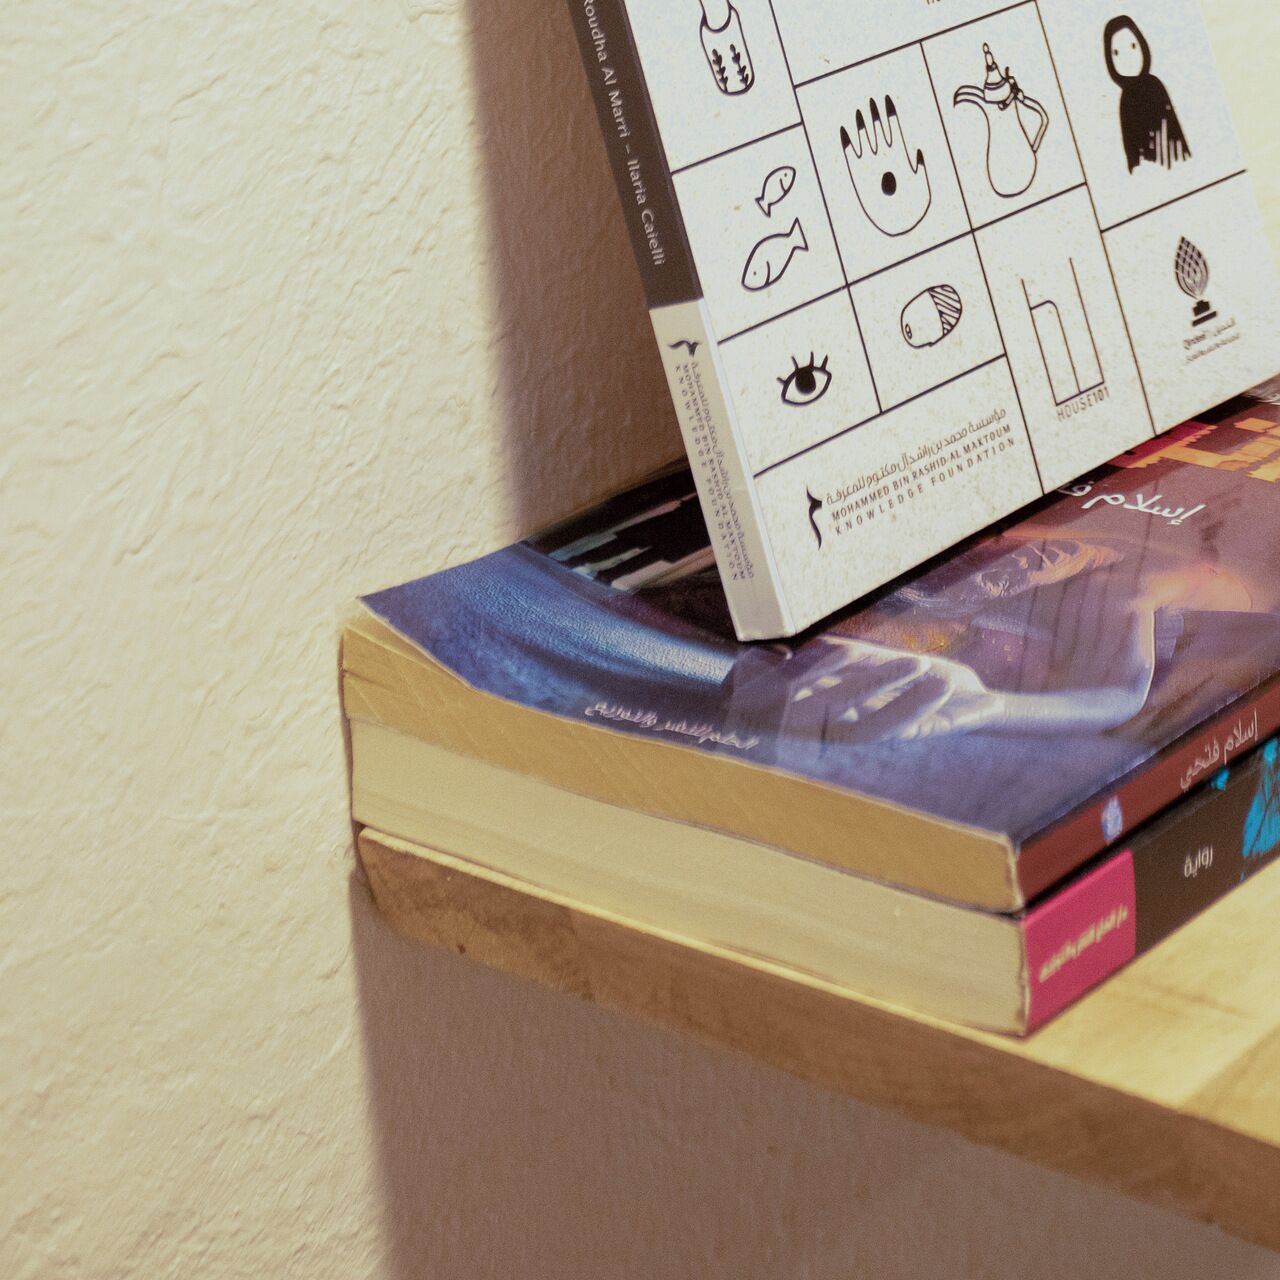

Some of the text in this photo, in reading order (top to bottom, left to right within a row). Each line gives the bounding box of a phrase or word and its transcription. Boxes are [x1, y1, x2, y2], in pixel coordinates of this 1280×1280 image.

[601, 66, 617, 86] Al
[608, 91, 630, 138] Marri
[627, 159, 646, 205] Ilaria
[641, 208, 666, 266] Caielli
[969, 409, 1006, 433] مؤسسة
[1056, 386, 1111, 422] HOUSE101
[943, 428, 968, 447] محمد
[674, 364, 738, 580] KNOWLEDGE FOUNDATION
[682, 362, 746, 580] MOHAMMED BIN RASHID AL MAKTOUM
[832, 424, 1011, 522] MOHAMMED BIN RASHID AL MAKTOUM
[835, 437, 1015, 536] KNOWLEDGE FOUNDATION
[1081, 493, 1206, 525] إسلام
[1180, 709, 1258, 792] إسلام فتحي
[1184, 845, 1213, 878] رواية
